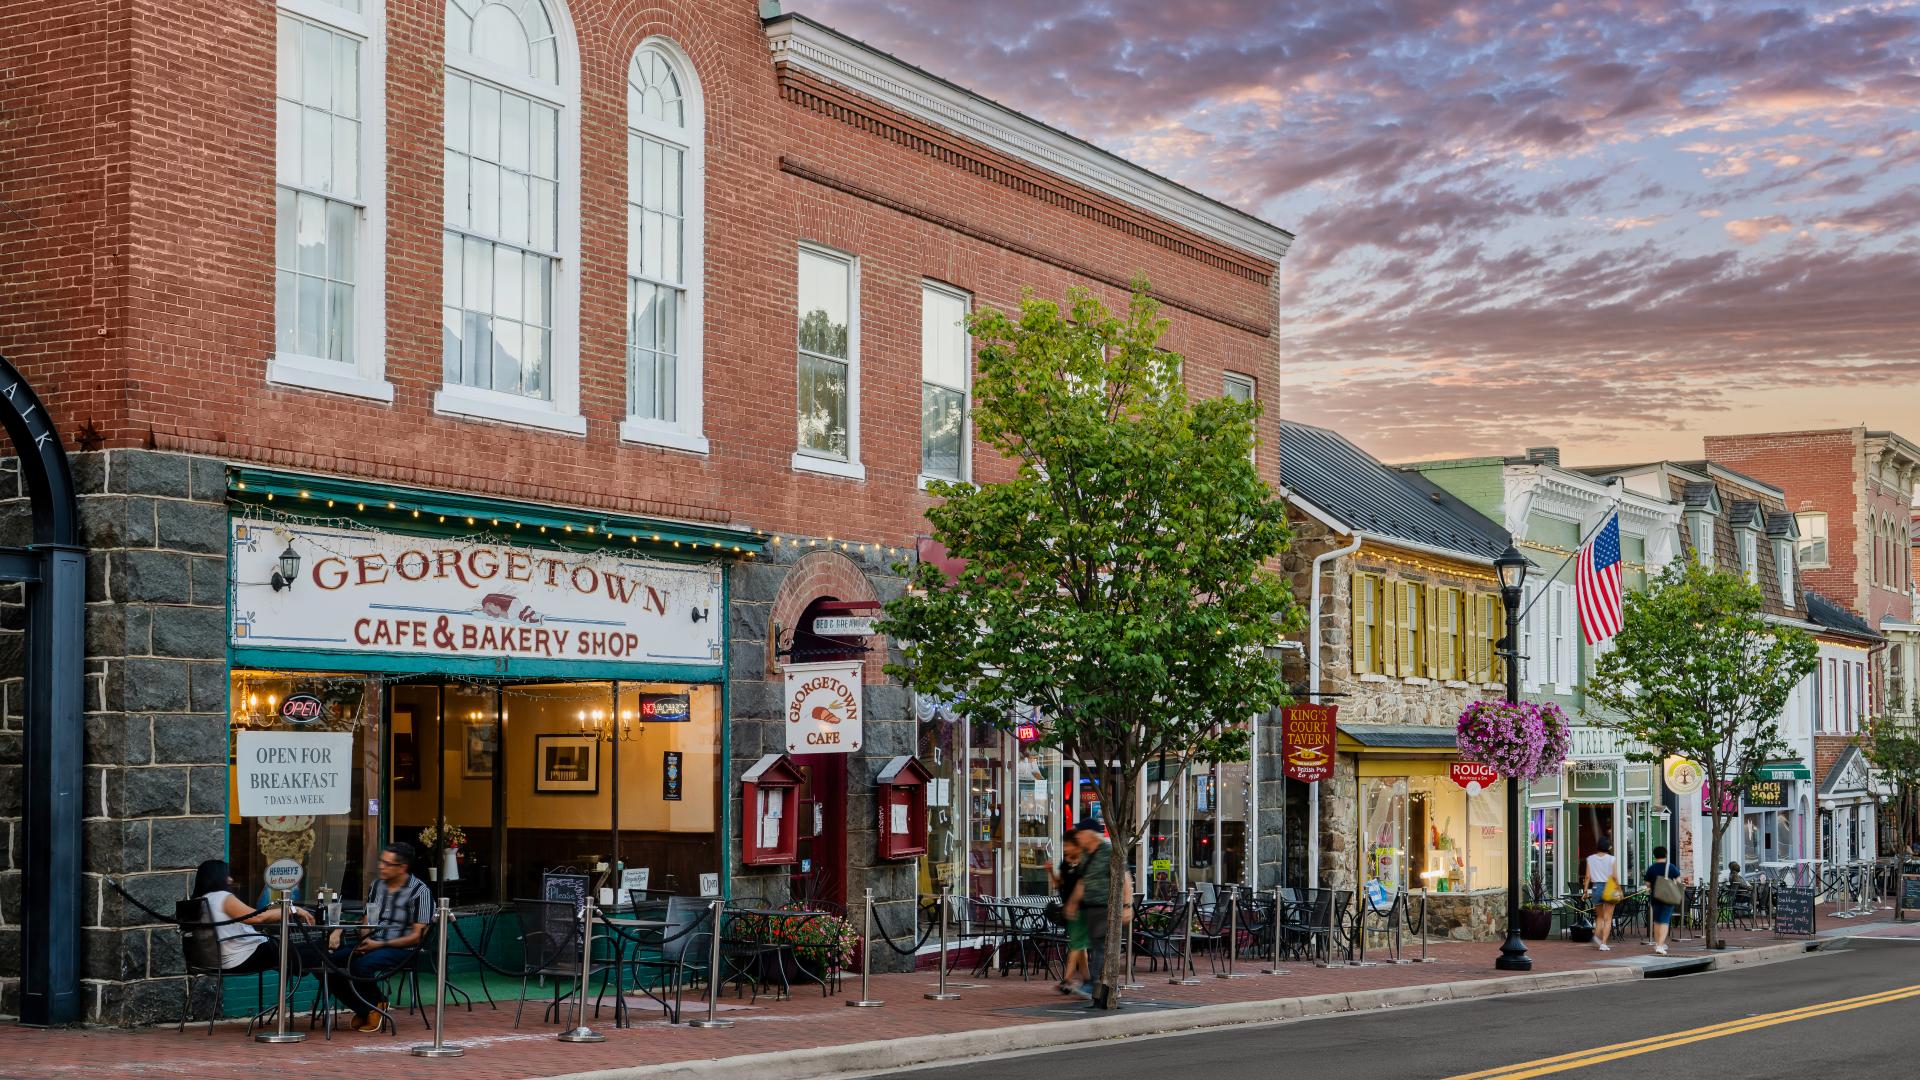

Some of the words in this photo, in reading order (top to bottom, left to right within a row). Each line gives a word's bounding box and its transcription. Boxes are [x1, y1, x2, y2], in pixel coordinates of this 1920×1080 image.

[312, 548, 670, 617] GEORGETOWN
[354, 617, 428, 648] CAFE
[433, 615, 459, 652] &
[462, 624, 570, 657] BAKERY
[577, 630, 639, 658] SHOP
[789, 676, 857, 723] GEORGETOWN
[283, 701, 322, 716] OPEN
[642, 703, 654, 714] NO
[654, 703, 688, 714] VACANCY
[1290, 709, 1328, 721] KING'S
[1020, 727, 1034, 739] OPEN
[1289, 721, 1328, 733] COURT
[806, 732, 841, 745] CAFE
[1287, 733, 1330, 745] TAVERN
[1578, 730, 1605, 754] TREE
[256, 747, 298, 764] OPEN
[301, 747, 332, 764] FOR
[1453, 764, 1495, 776] ROUGE
[249, 772, 339, 789] BREAKFAST
[263, 795, 269, 805] 7
[270, 795, 292, 805] DAYS
[292, 795, 299, 804] A
[300, 794, 325, 804] WEEK
[269, 866, 299, 876] HERSHEY'S
[703, 875, 718, 892] Open
